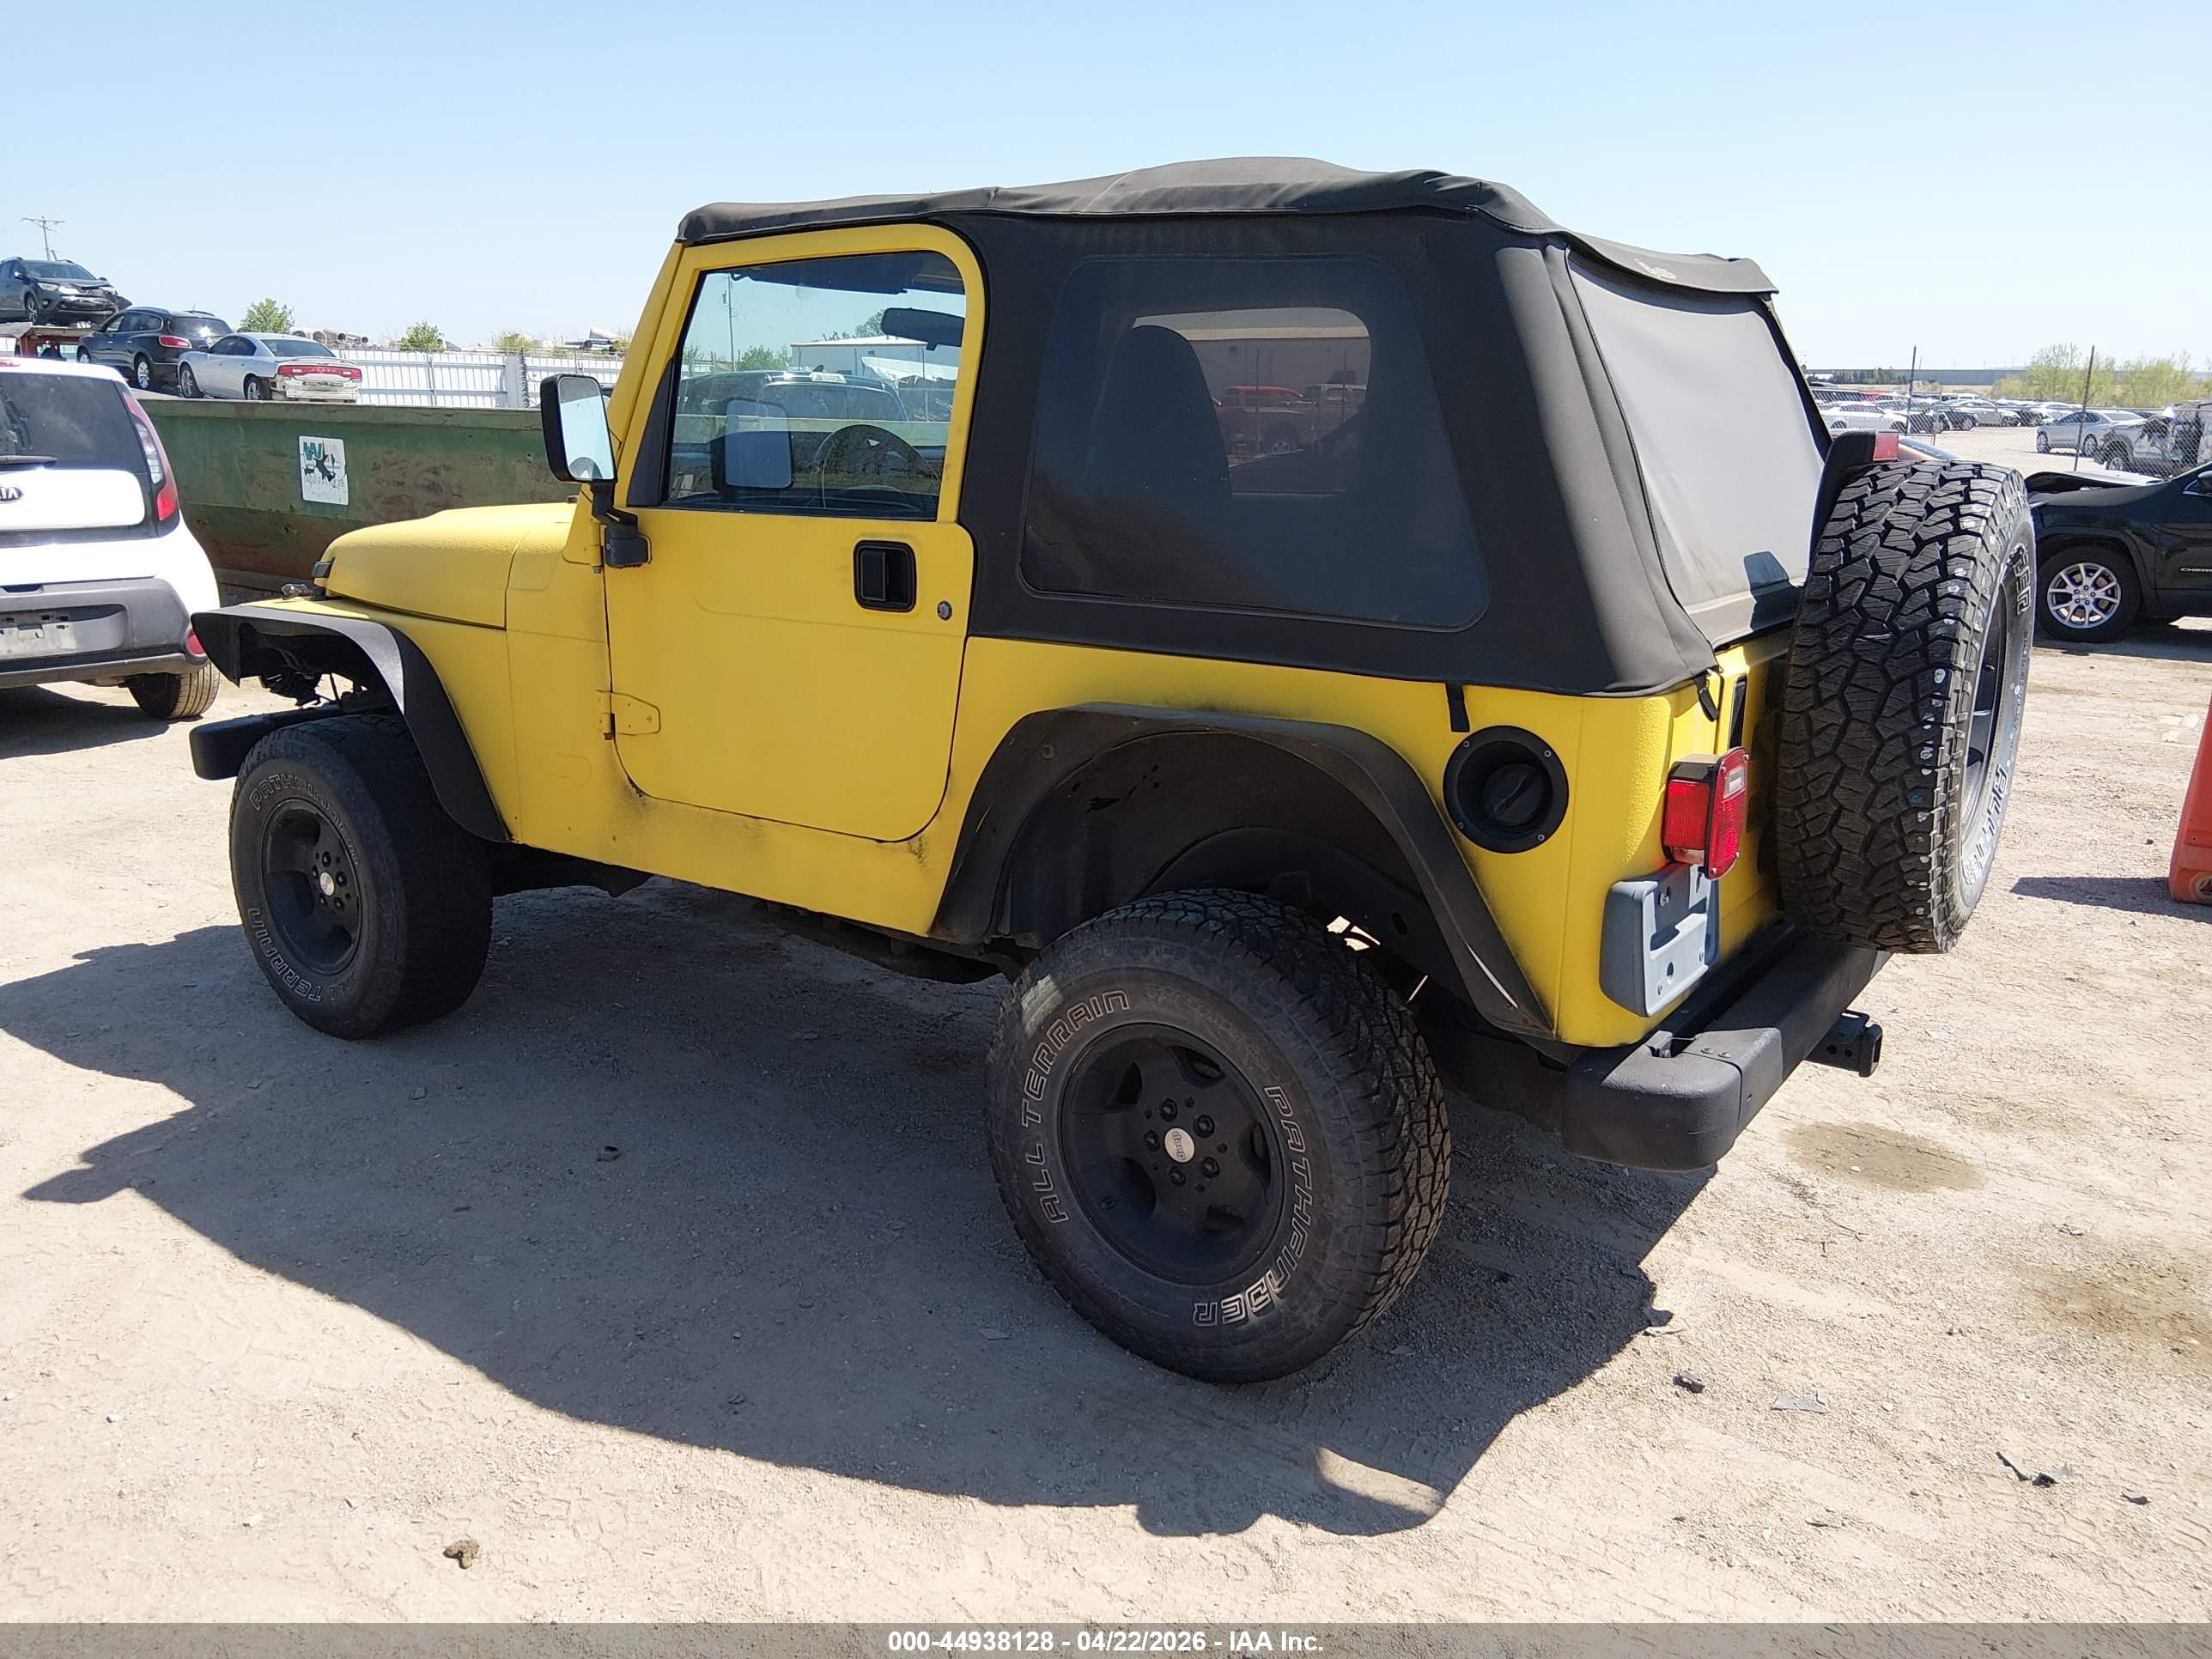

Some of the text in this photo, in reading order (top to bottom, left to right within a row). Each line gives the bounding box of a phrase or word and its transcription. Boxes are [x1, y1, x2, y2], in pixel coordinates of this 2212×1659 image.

[0, 487, 19, 499] IA
[247, 908, 322, 1002] TERRAIN
[1021, 990, 1130, 1224] ALL TERRAIN
[1172, 1131, 1187, 1161] Jeep
[1192, 1085, 1315, 1327] PATHFINDER
